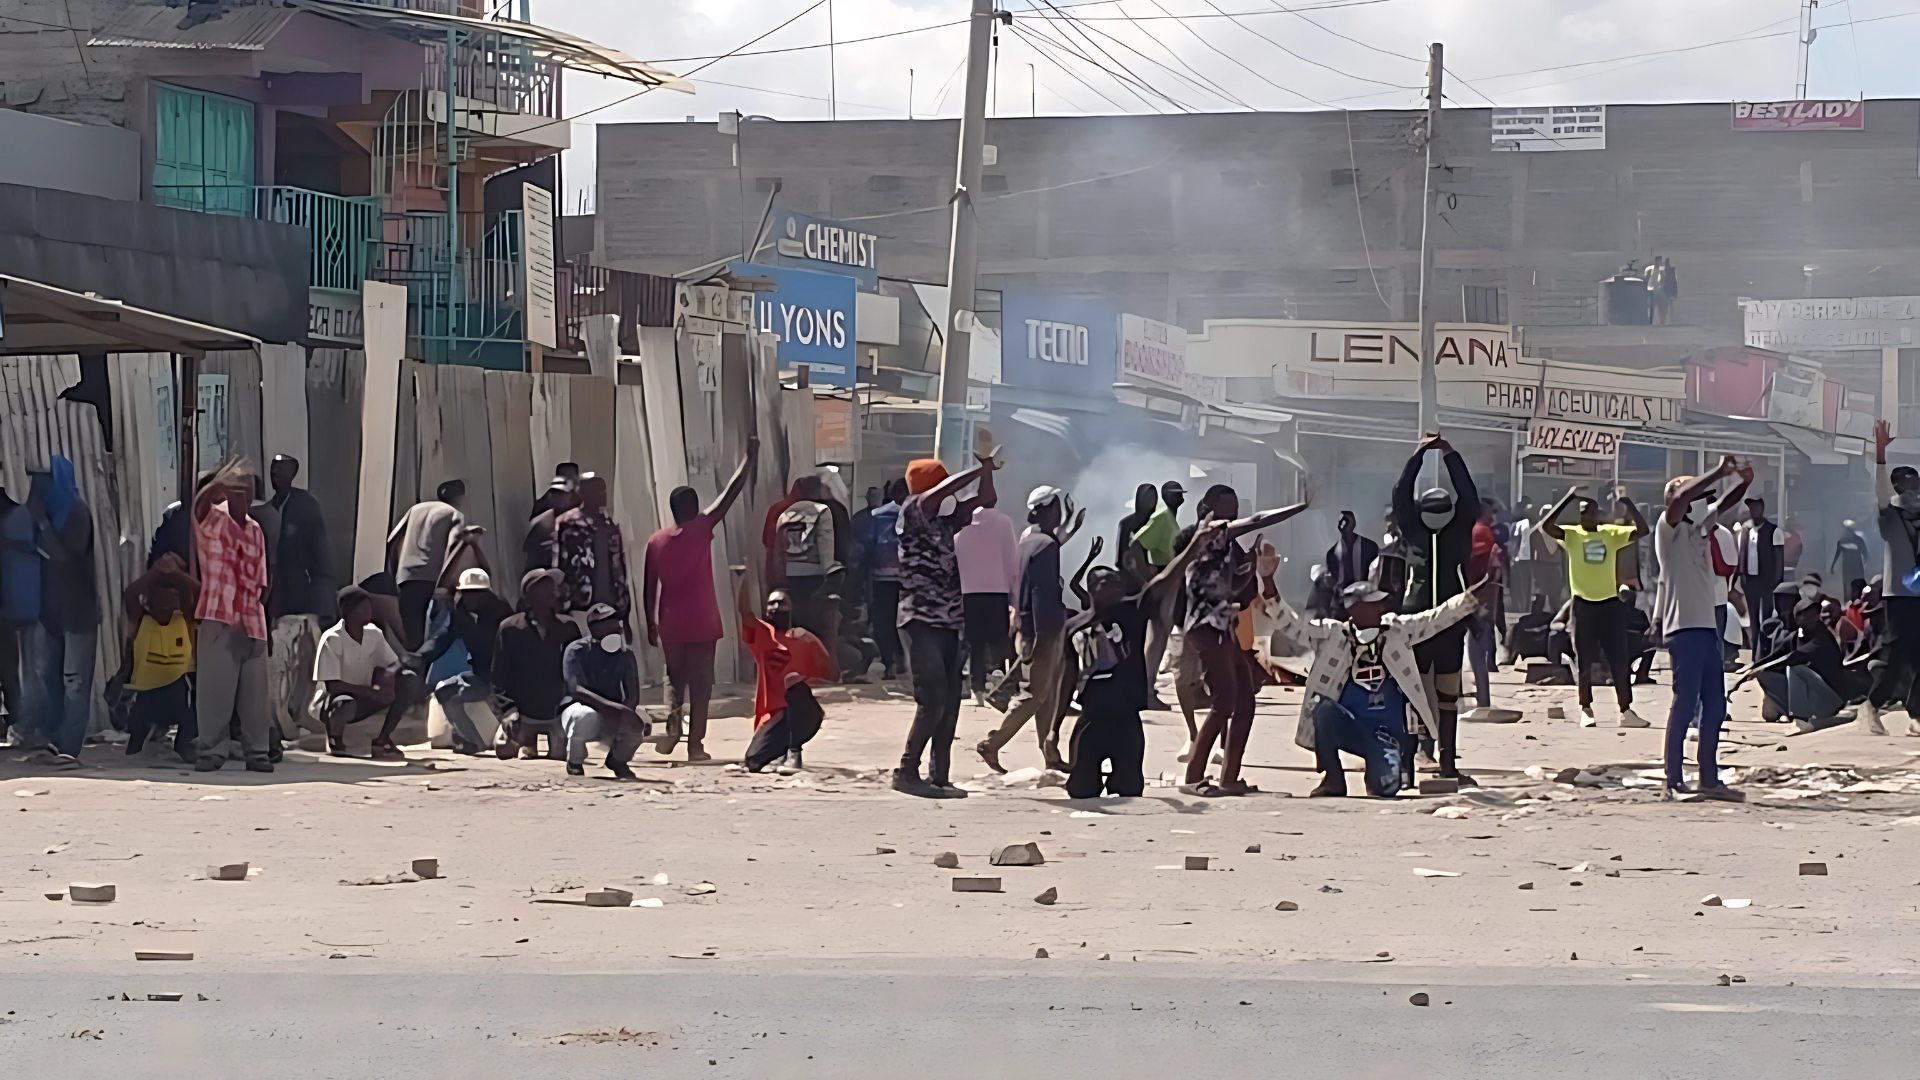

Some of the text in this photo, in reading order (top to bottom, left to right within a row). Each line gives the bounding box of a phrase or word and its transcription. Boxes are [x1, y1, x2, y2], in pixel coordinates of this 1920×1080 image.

[805, 223, 877, 269] CHEMIST
[1311, 332, 1508, 368] LENANA
[1486, 382, 1653, 421] PHARACEUTICALS
